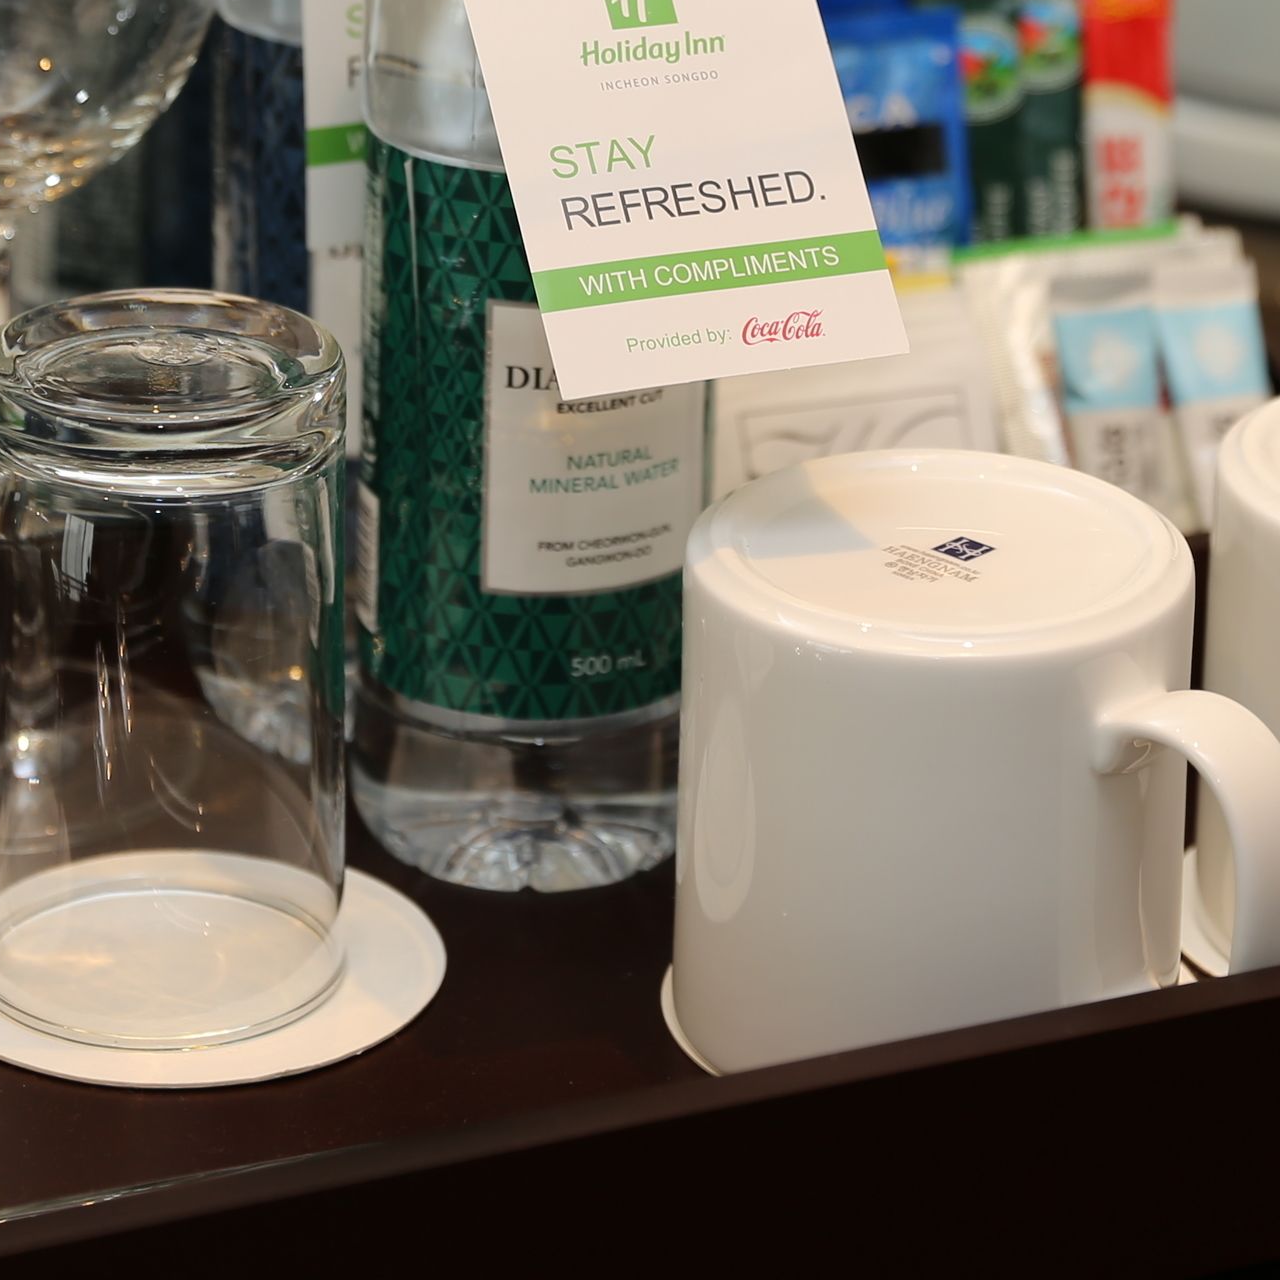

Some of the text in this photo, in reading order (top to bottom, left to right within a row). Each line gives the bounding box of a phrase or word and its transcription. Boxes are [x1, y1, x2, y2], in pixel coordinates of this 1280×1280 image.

[580, 30, 725, 67] Holiday Inn
[600, 70, 719, 92] INCHEON SONGDO
[549, 134, 656, 179] STAY
[560, 170, 826, 231] REFRESHED.
[578, 245, 840, 297] WITH COMPLIMENTS
[626, 327, 702, 353] Provided
[706, 328, 732, 346] by:
[556, 389, 664, 415] EXCELLENT CUT
[566, 445, 653, 471] NATURAL
[528, 456, 681, 494] MINERAL WATER
[537, 541, 575, 552] FROM
[882, 545, 980, 583] HAENGNAM
[570, 655, 613, 678] 500
